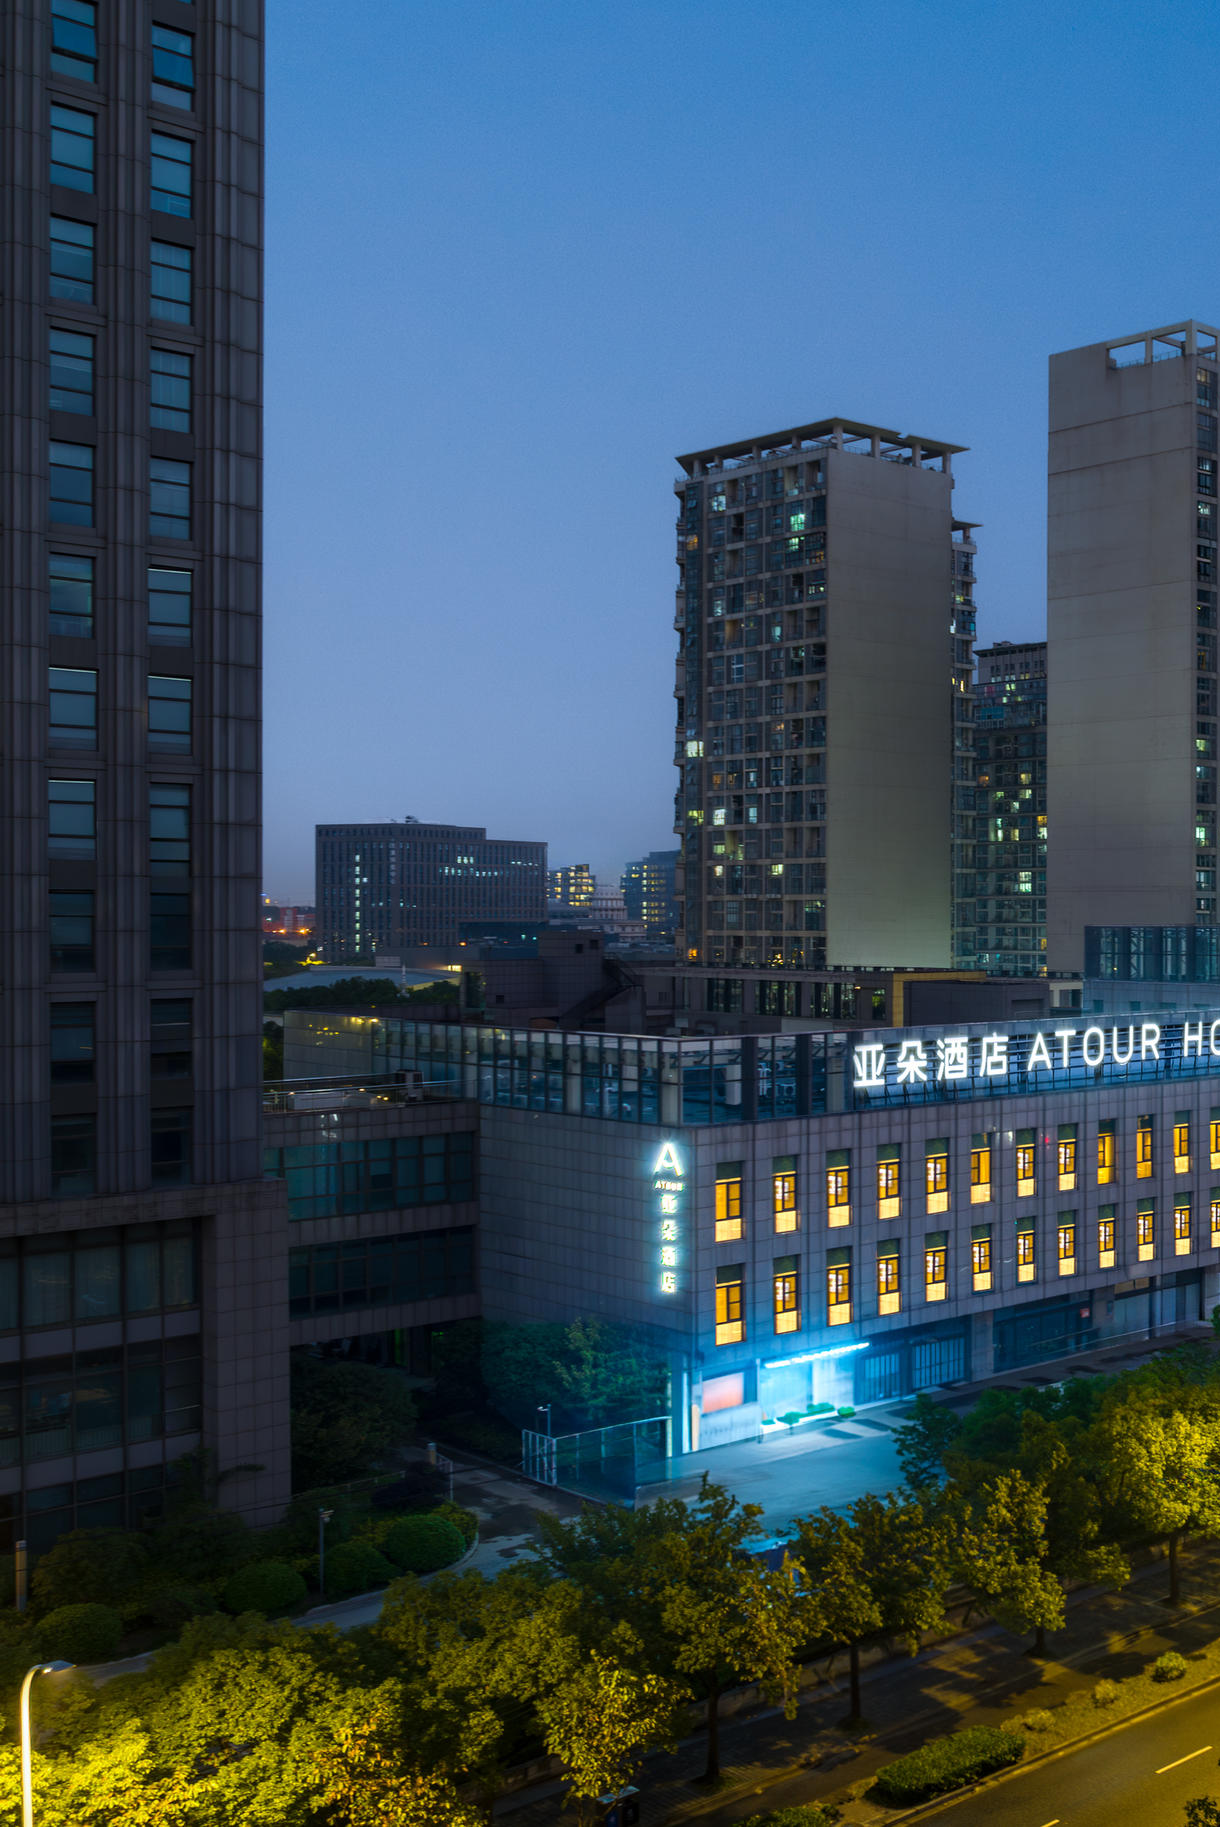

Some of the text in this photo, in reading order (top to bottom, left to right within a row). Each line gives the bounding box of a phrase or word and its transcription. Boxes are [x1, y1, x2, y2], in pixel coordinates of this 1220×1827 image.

[853, 1032, 1009, 1087] 亚朵酒店
[1027, 1023, 1161, 1071] ATOUR
[654, 1142, 683, 1177] A
